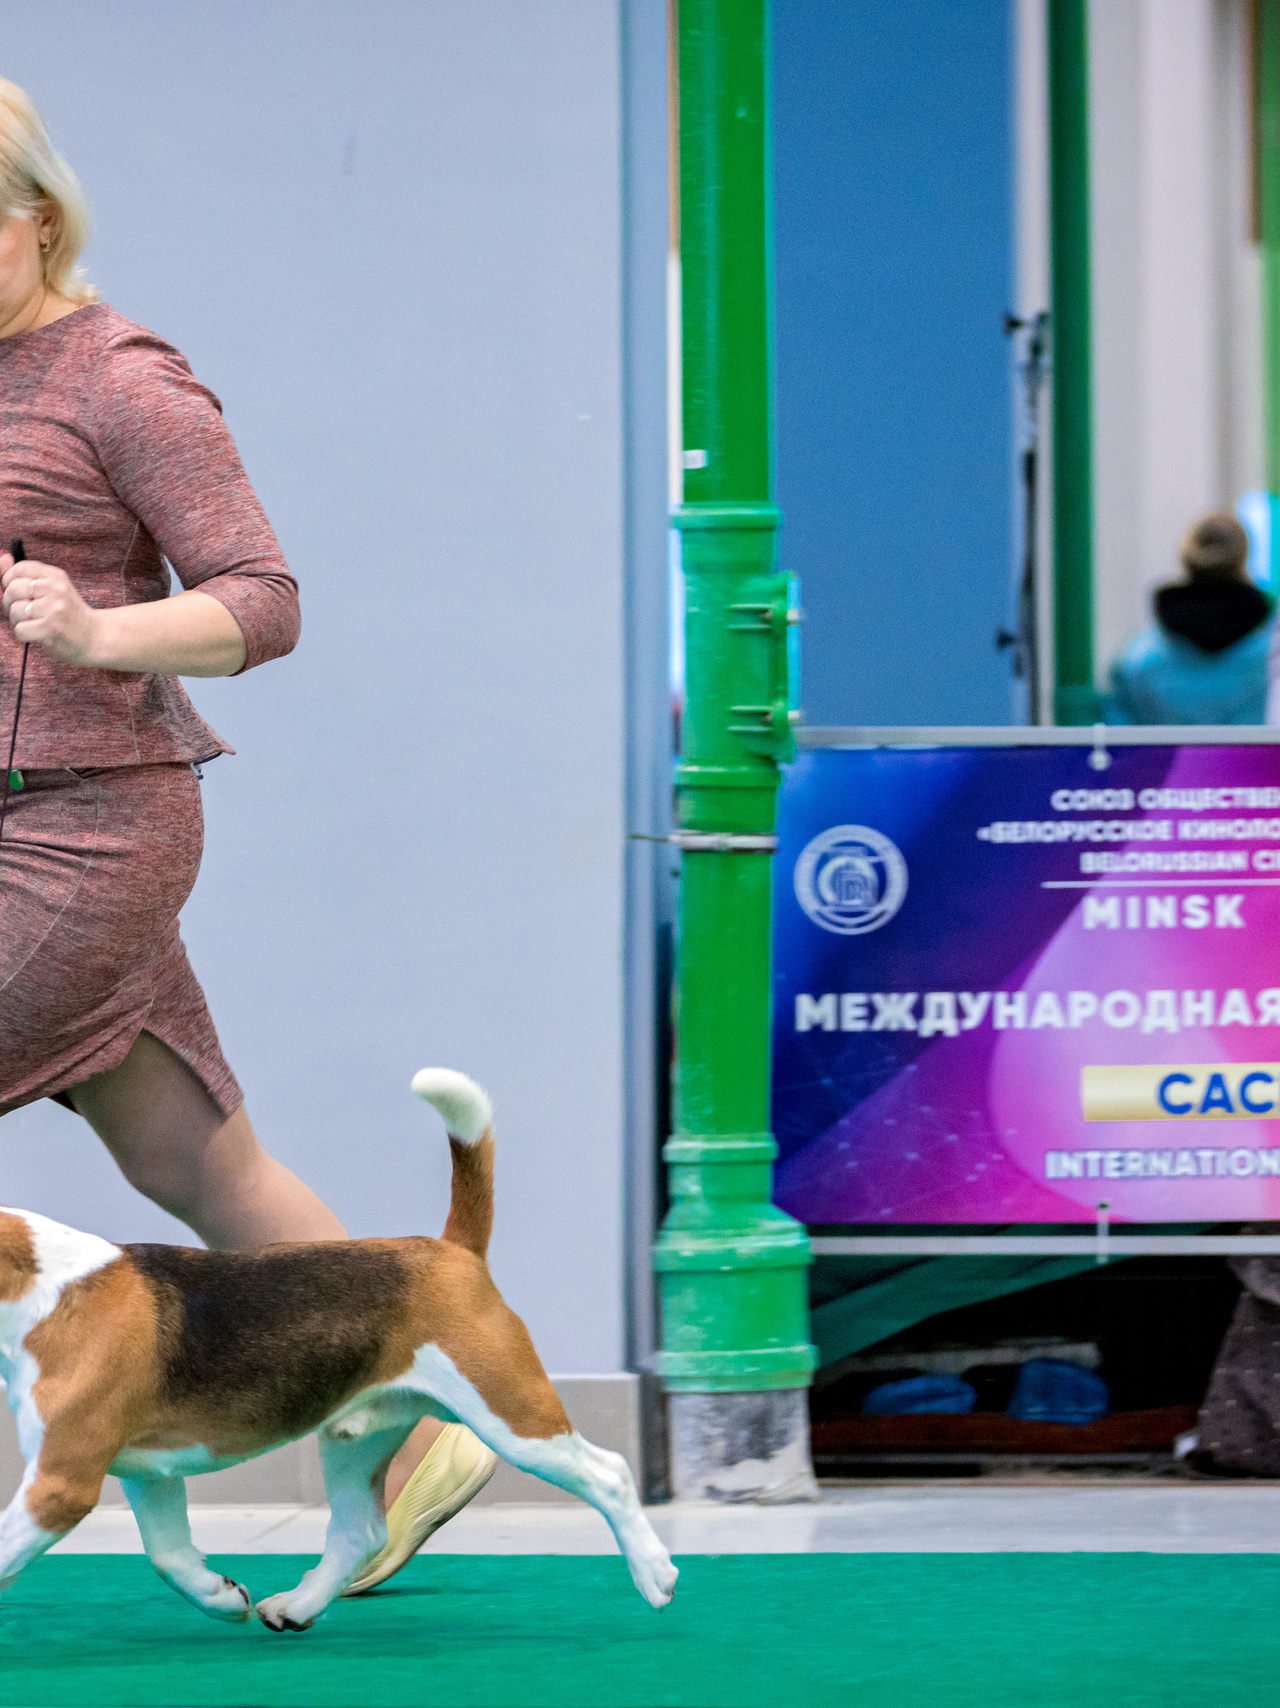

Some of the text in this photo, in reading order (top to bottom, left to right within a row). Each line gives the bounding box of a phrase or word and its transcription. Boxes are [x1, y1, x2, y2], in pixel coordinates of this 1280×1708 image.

[1081, 894, 1245, 930] MINSK
[794, 986, 1280, 1037] МЕЖДУНАРОДНАЯ
[1157, 1071, 1280, 1116] CAC
